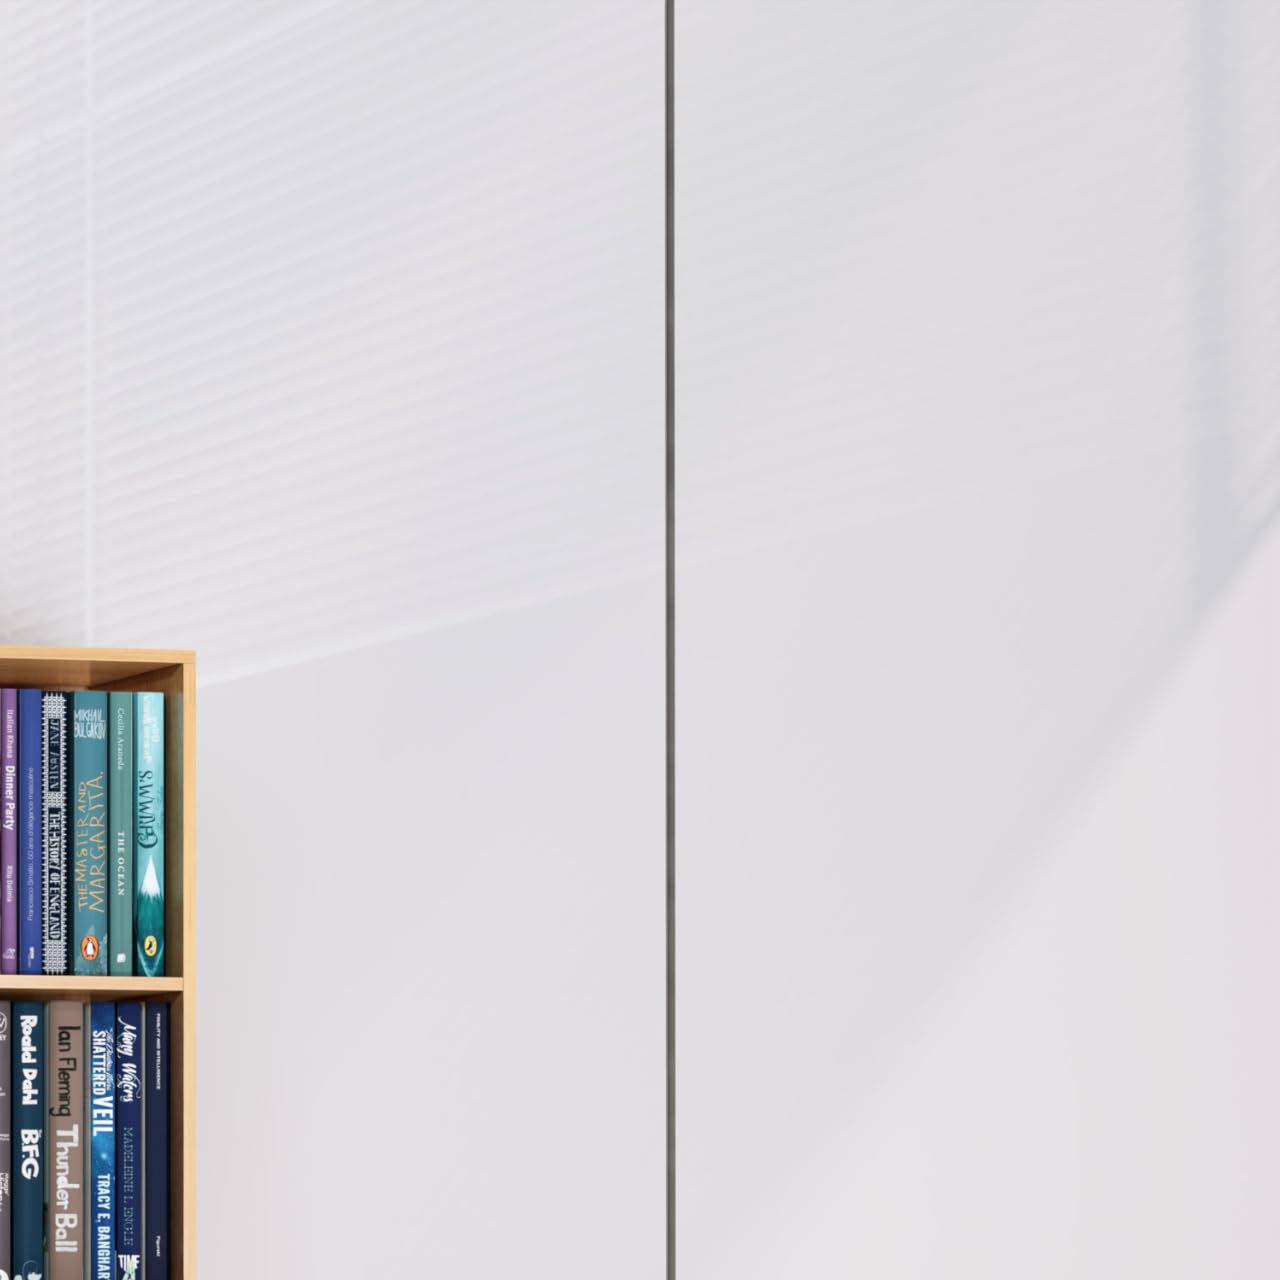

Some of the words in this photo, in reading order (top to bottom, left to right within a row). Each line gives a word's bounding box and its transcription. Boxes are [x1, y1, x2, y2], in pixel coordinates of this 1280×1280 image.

[5, 765, 15, 799] Dinner
[4, 803, 15, 830] Party
[21, 1015, 37, 1063] Roald
[58, 1026, 80, 1052] Ian
[92, 1030, 106, 1095] SHATTERED
[22, 1068, 37, 1105] Dahl
[49, 1058, 76, 1116] Fleming
[93, 1096, 113, 1136] VEIL
[56, 1124, 79, 1209] Thunder
[55, 1213, 78, 1252] Ball
